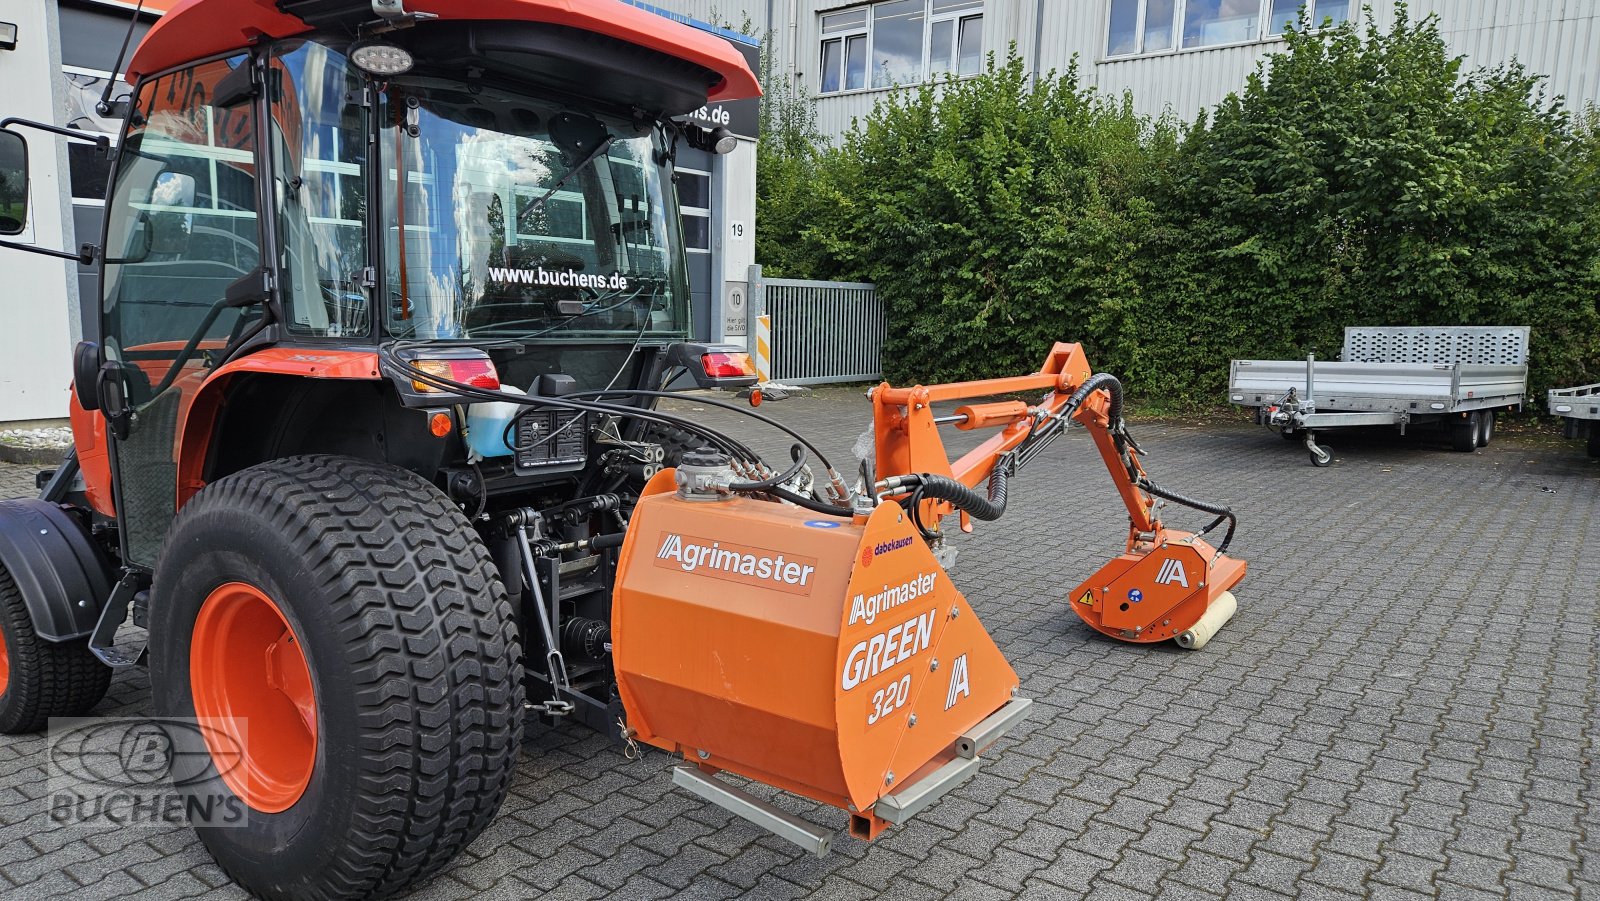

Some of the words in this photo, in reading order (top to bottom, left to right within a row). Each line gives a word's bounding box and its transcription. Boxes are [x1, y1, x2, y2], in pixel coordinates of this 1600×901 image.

[731, 223, 743, 237] 19
[488, 266, 628, 290] www.buchens.de
[732, 293, 741, 306] 10
[657, 534, 815, 586] Agrimaster
[874, 536, 913, 556] dabekausen
[848, 572, 937, 626] Agrimaster
[841, 608, 937, 692] GREEN
[867, 673, 912, 725] 320
